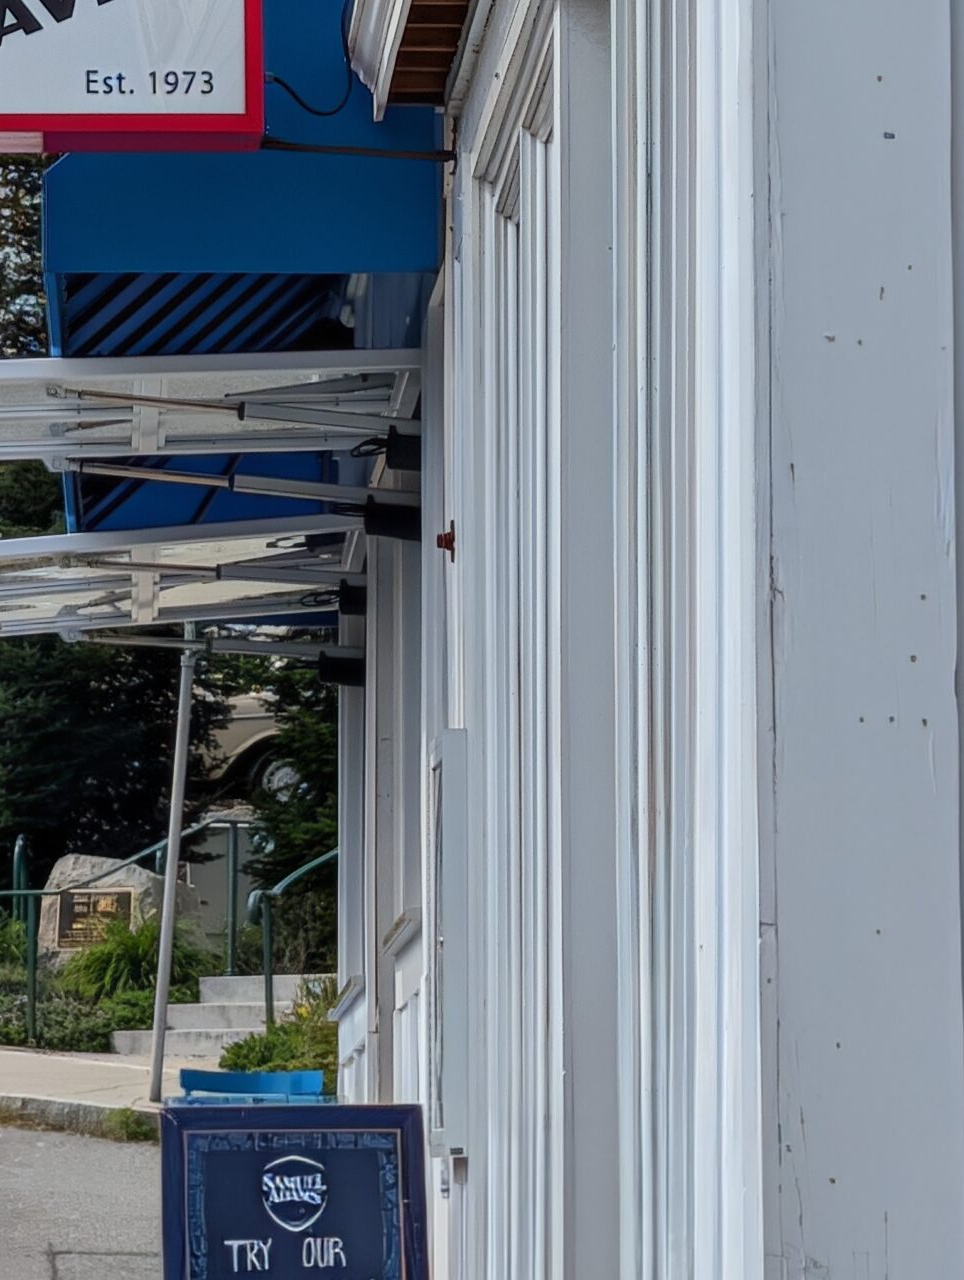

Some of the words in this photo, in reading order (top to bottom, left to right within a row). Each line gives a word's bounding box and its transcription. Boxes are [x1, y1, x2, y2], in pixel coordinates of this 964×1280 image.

[85, 70, 135, 95] Est.
[148, 70, 215, 95] 1973
[224, 1238, 272, 1272] TRY
[303, 1237, 347, 1268] OUR
